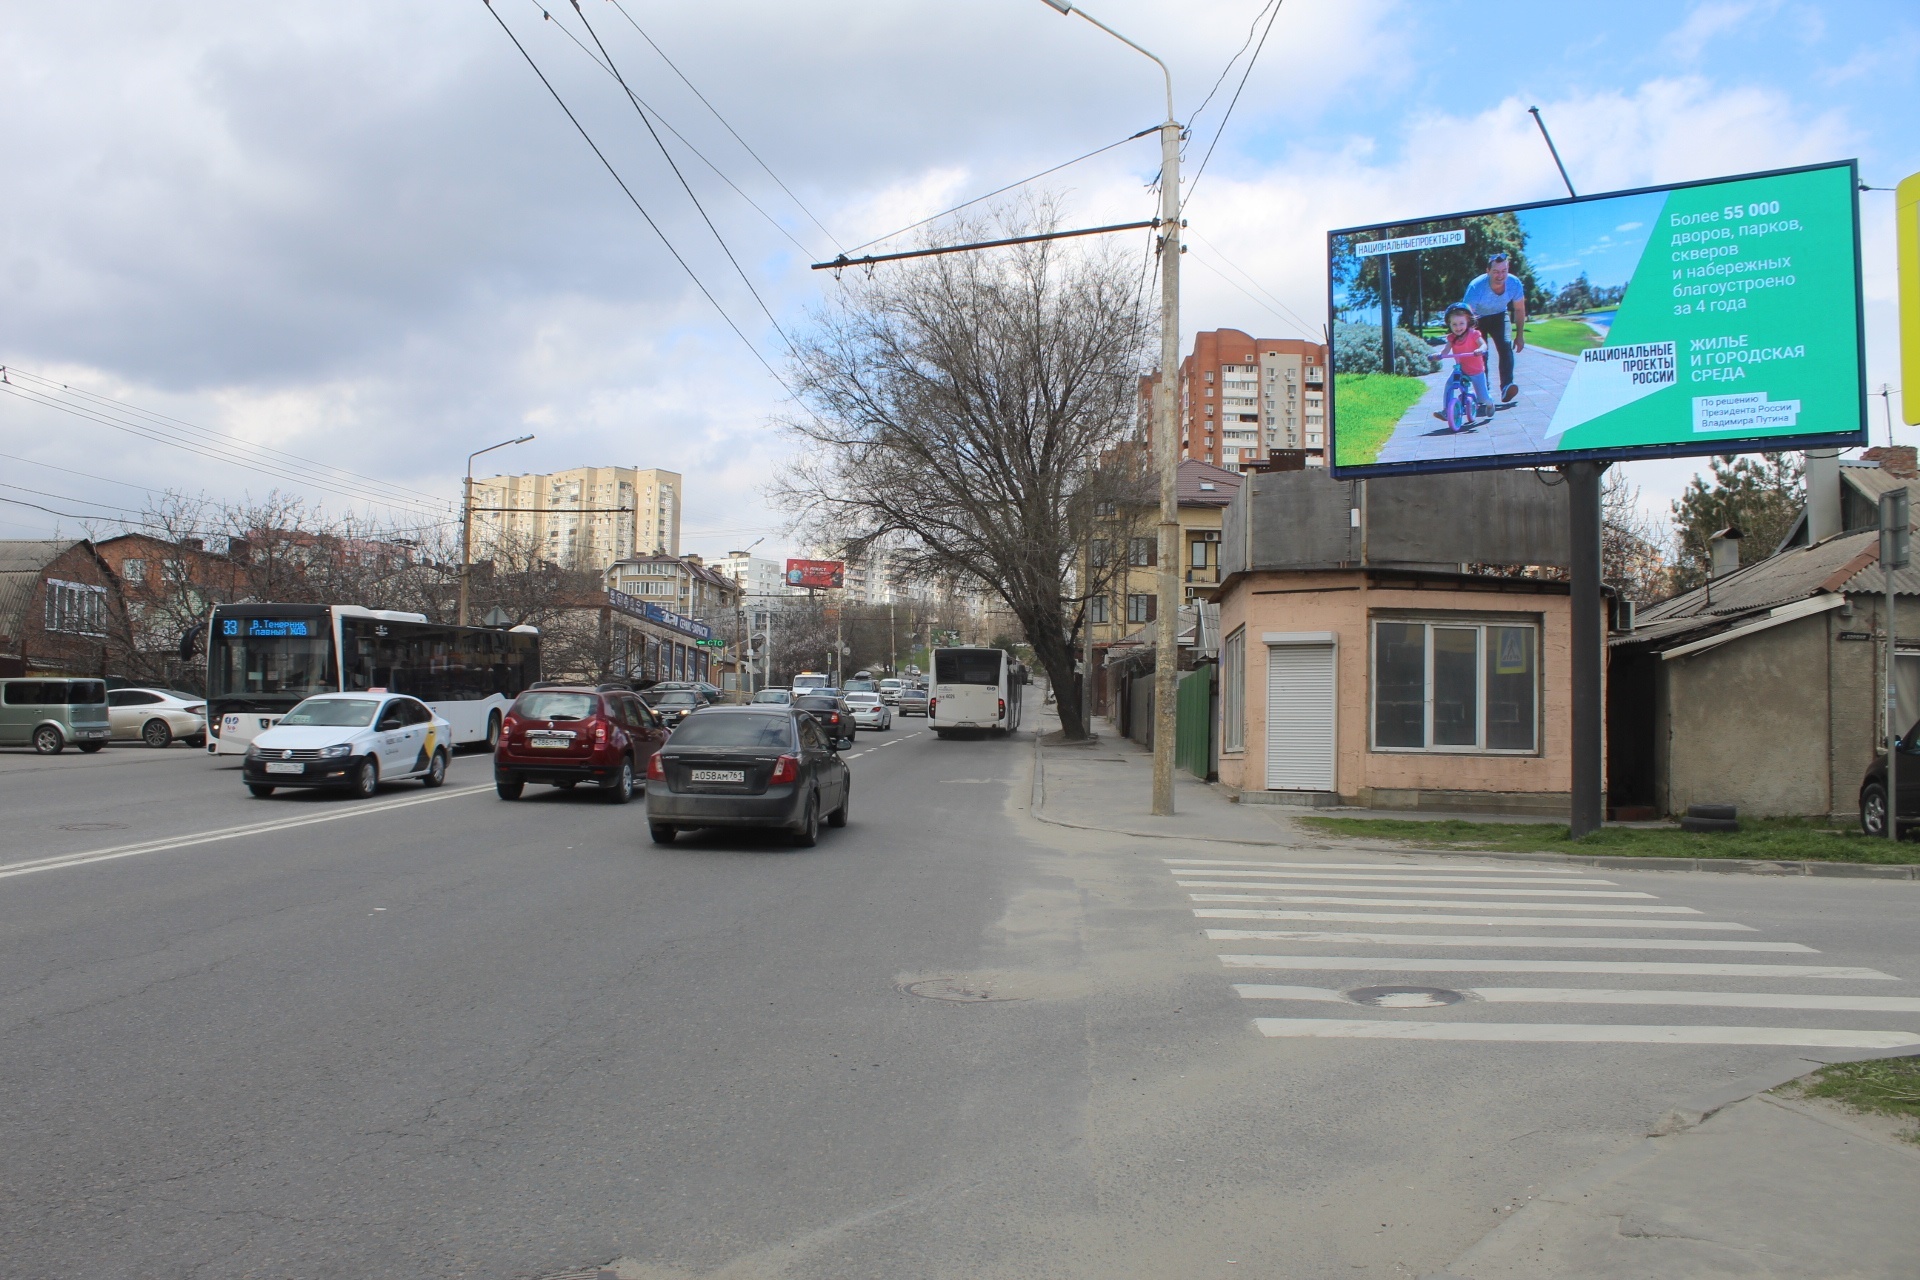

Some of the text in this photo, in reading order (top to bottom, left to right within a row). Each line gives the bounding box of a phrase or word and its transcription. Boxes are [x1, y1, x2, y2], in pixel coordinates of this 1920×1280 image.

[1670, 200, 1780, 227] Более 55 000
[1670, 219, 1803, 247] дворов, парков,
[1358, 233, 1462, 255] НАЦИОНАЛЬНЫЕПРОЕКТЫ.РФ
[1671, 244, 1739, 262] скверов
[1672, 256, 1792, 280] и набережных
[1672, 274, 1796, 298] благоустроено
[1673, 297, 1747, 316] за 4 года
[1690, 335, 1749, 351] ЖИЛЬЕ
[1584, 343, 1674, 363] НАЦИОНАЛЬНЫЕ
[1690, 345, 1805, 367] И ГОРОДСКАЯ
[1622, 357, 1674, 373] ПРОЕКТЫ
[1632, 370, 1675, 385] РОССИИ
[1691, 366, 1746, 383] СРЕДА
[1701, 396, 1759, 407] По решению
[1701, 404, 1792, 418] Президента России
[1702, 415, 1789, 428] Владимира Путина
[223, 620, 238, 635] 33
[249, 628, 286, 636] Главный
[707, 639, 724, 647] СТО
